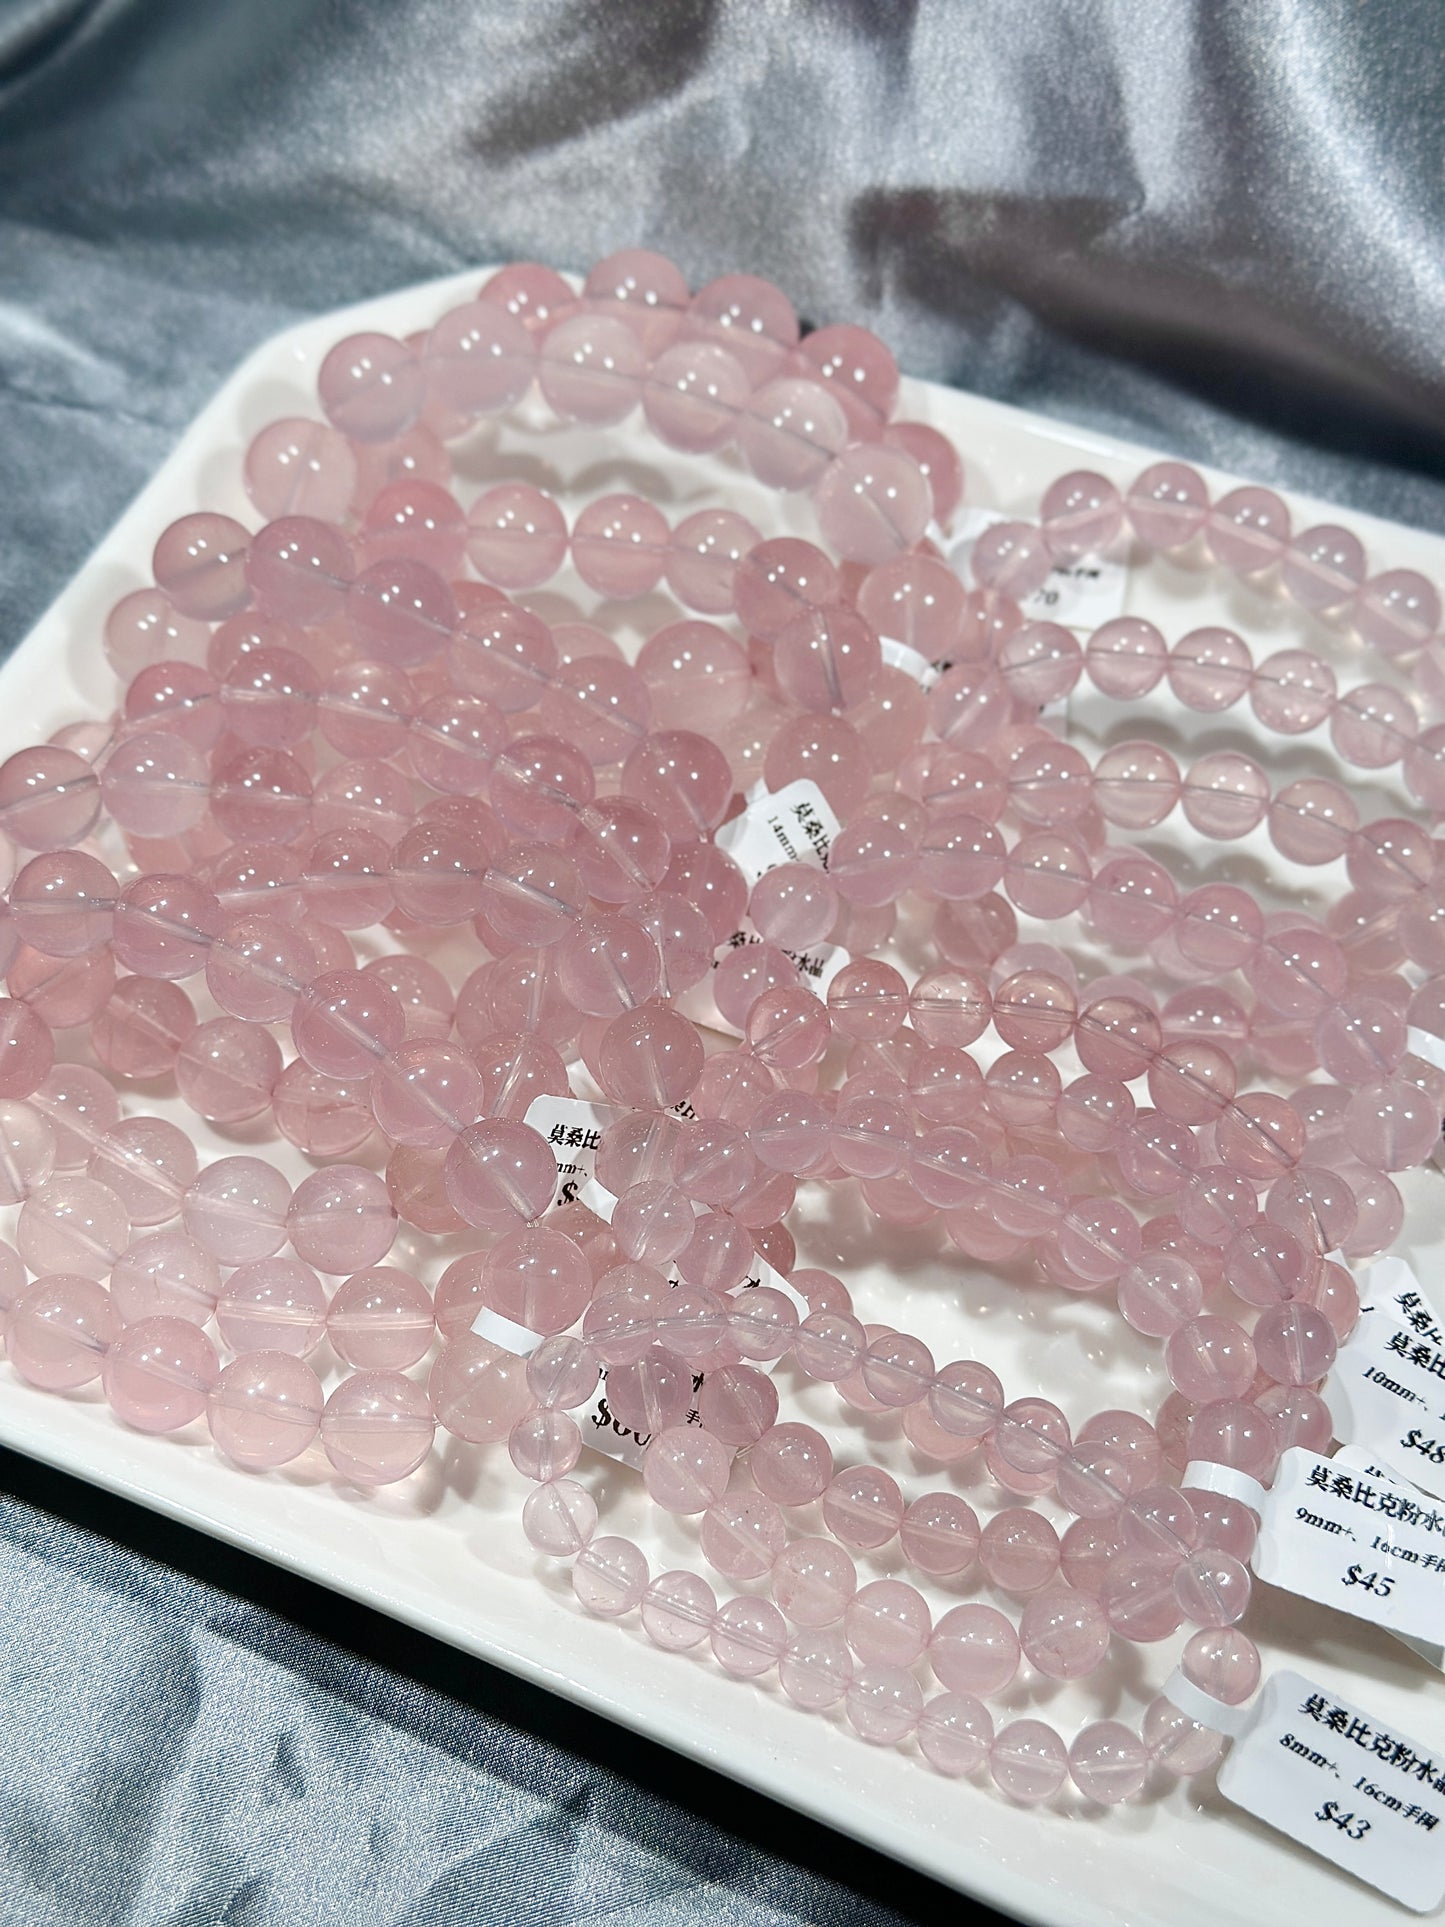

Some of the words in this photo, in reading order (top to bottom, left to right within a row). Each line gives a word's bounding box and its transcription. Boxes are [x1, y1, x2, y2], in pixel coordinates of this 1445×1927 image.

[547, 1123, 601, 1150] 莫桑比
[1400, 1429, 1445, 1463] $48
[1305, 1464, 1445, 1537] 莫桑比克粉水
[1341, 1564, 1396, 1598] $45
[1315, 1801, 1371, 1839] $43
